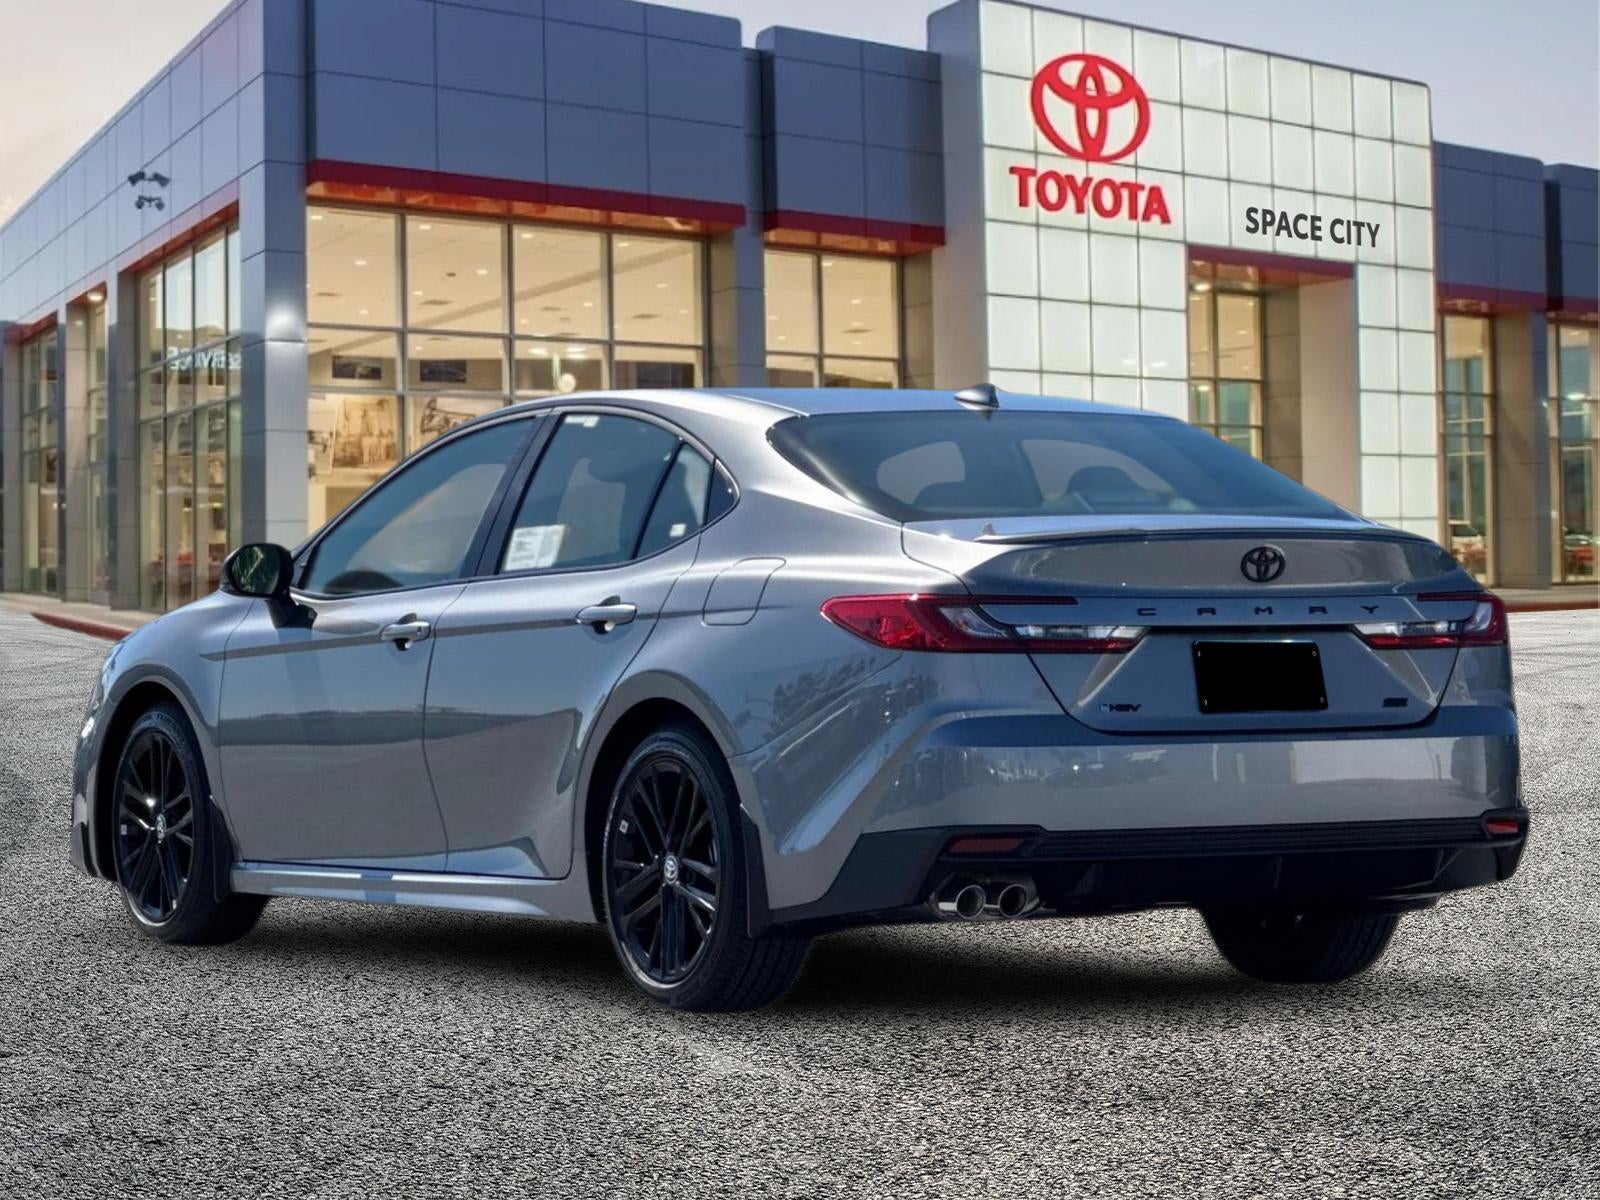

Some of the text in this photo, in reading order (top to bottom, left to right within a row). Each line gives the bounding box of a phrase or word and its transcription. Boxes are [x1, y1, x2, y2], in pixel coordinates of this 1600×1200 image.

[1009, 166, 1171, 225] TOYOTA
[1245, 207, 1381, 248] SPACE CITY
[1137, 605, 1379, 616] CAMRY
